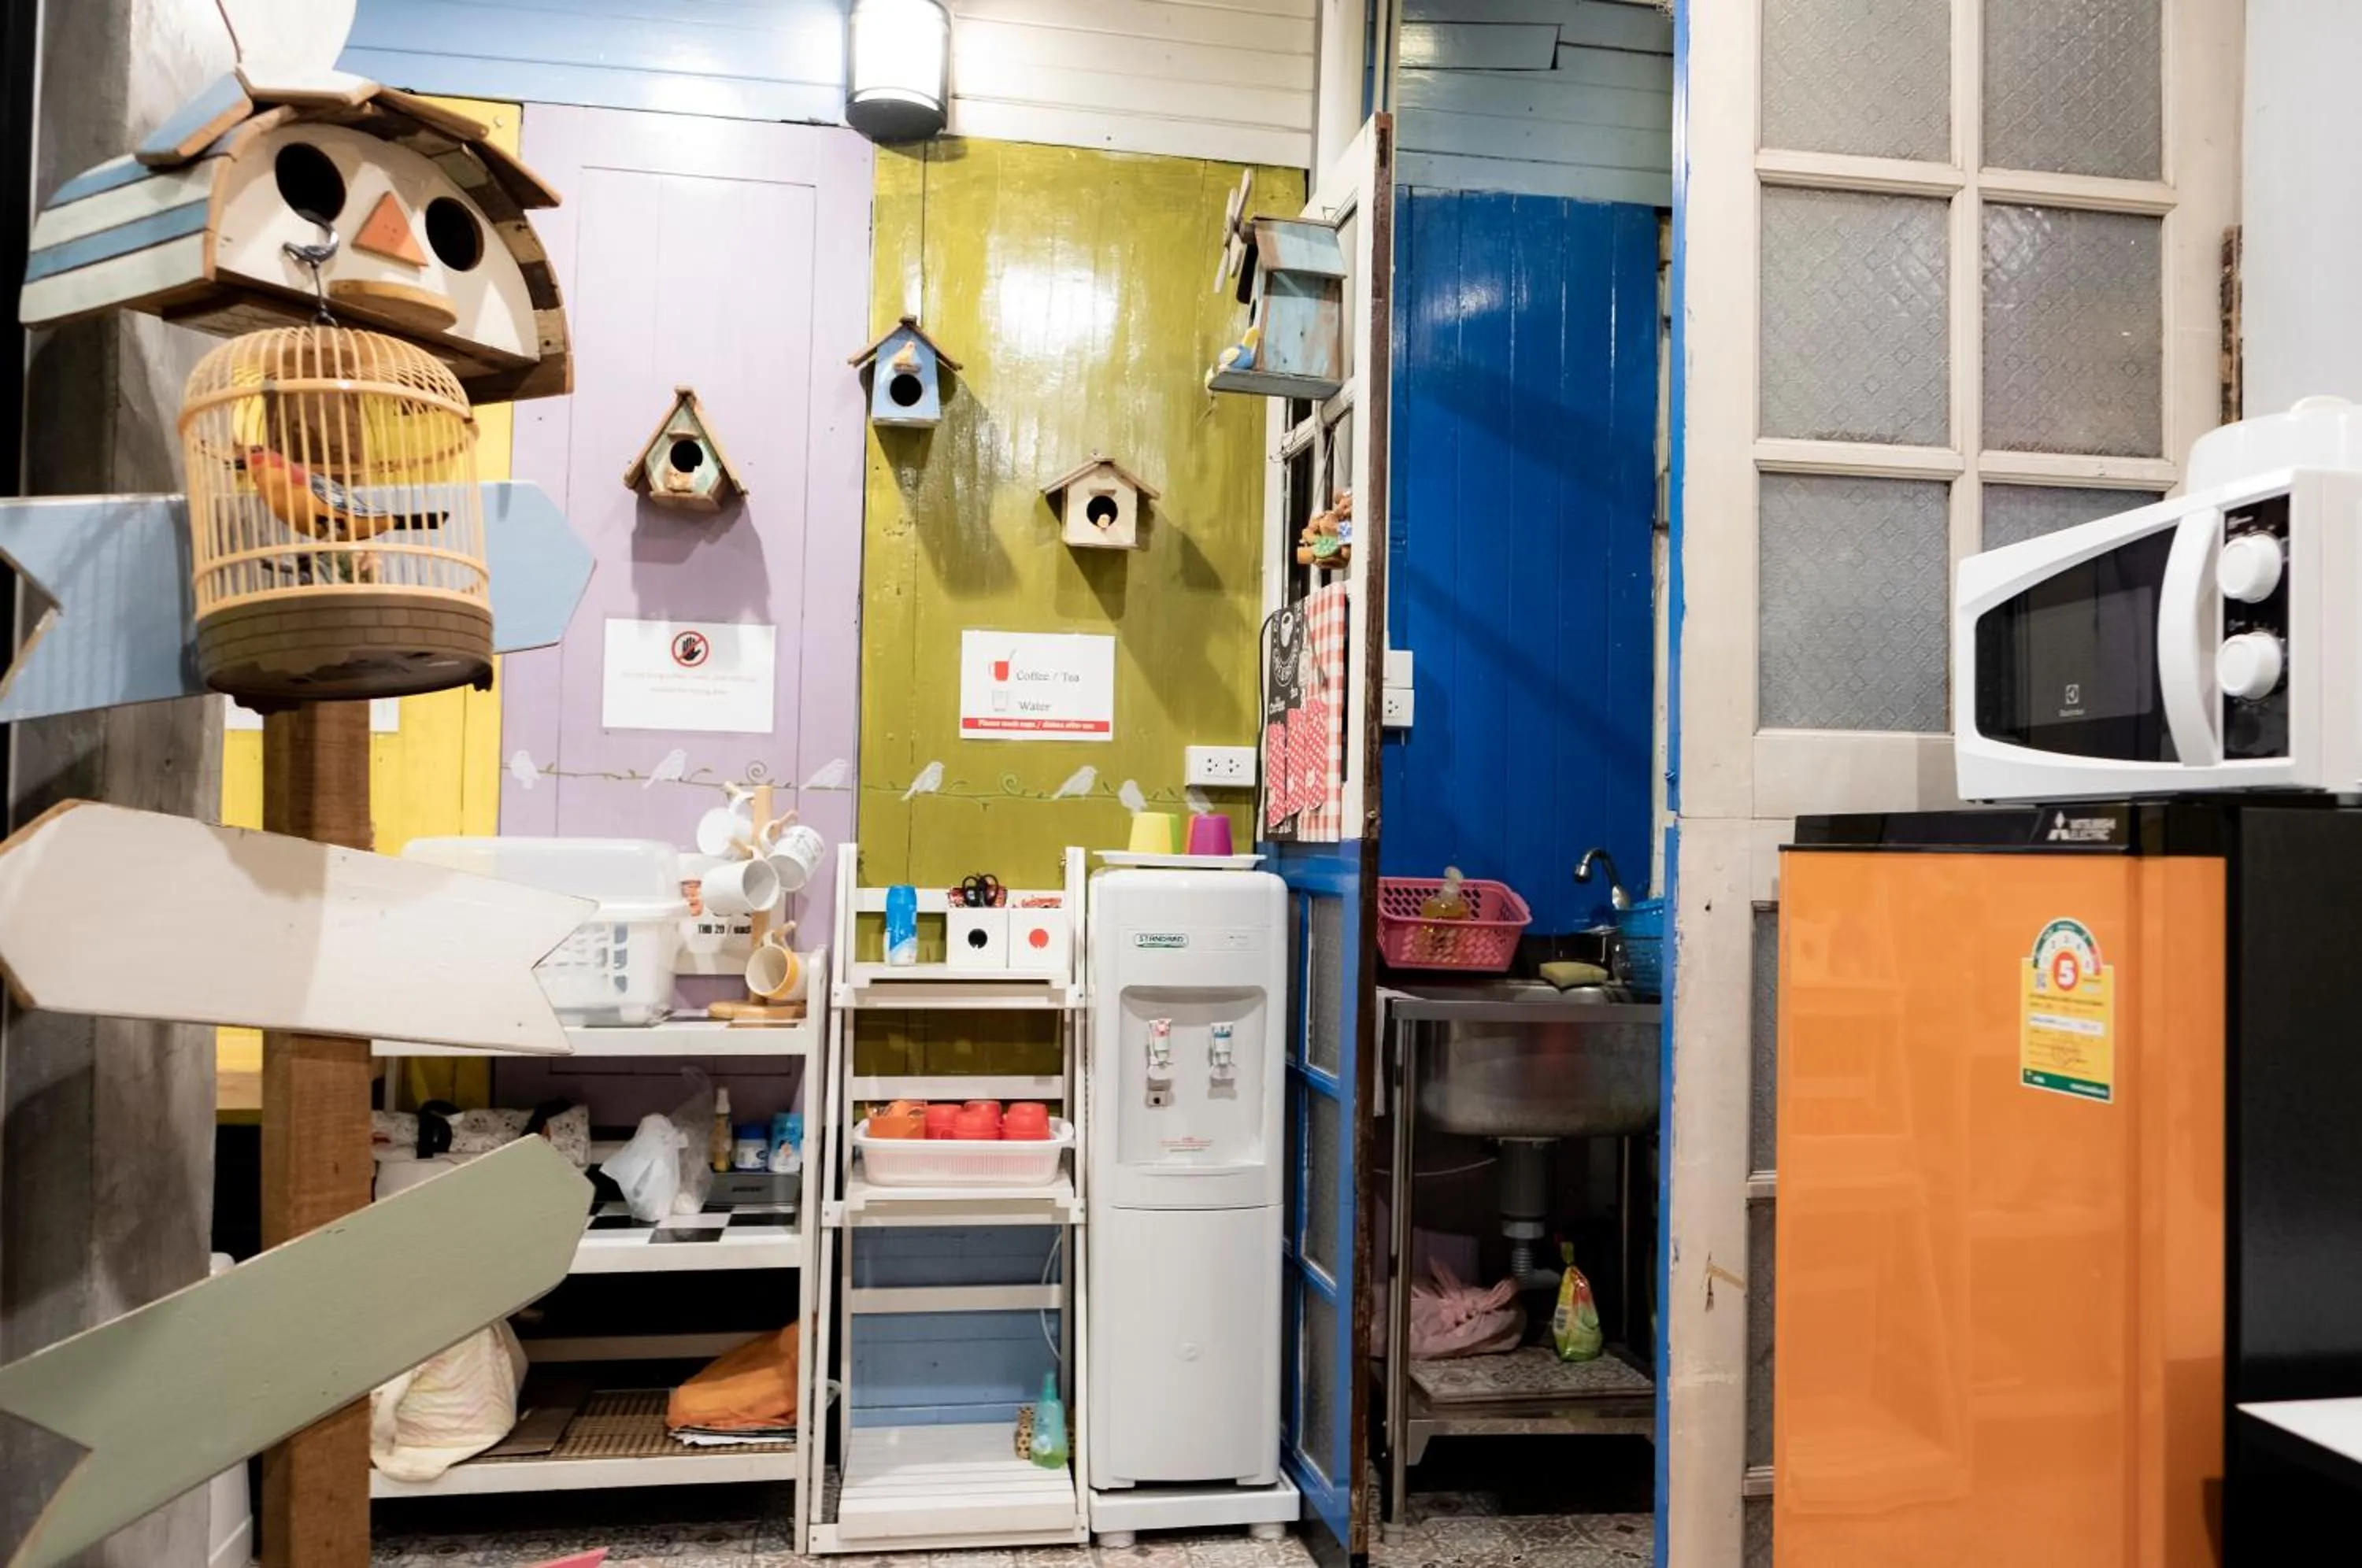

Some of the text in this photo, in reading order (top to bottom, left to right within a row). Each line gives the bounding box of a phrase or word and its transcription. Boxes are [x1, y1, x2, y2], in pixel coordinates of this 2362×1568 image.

[1016, 669, 1050, 681] Coffee
[1061, 671, 1080, 682] Tea
[1019, 701, 1052, 712] Water
[2057, 959, 2075, 987] 5
